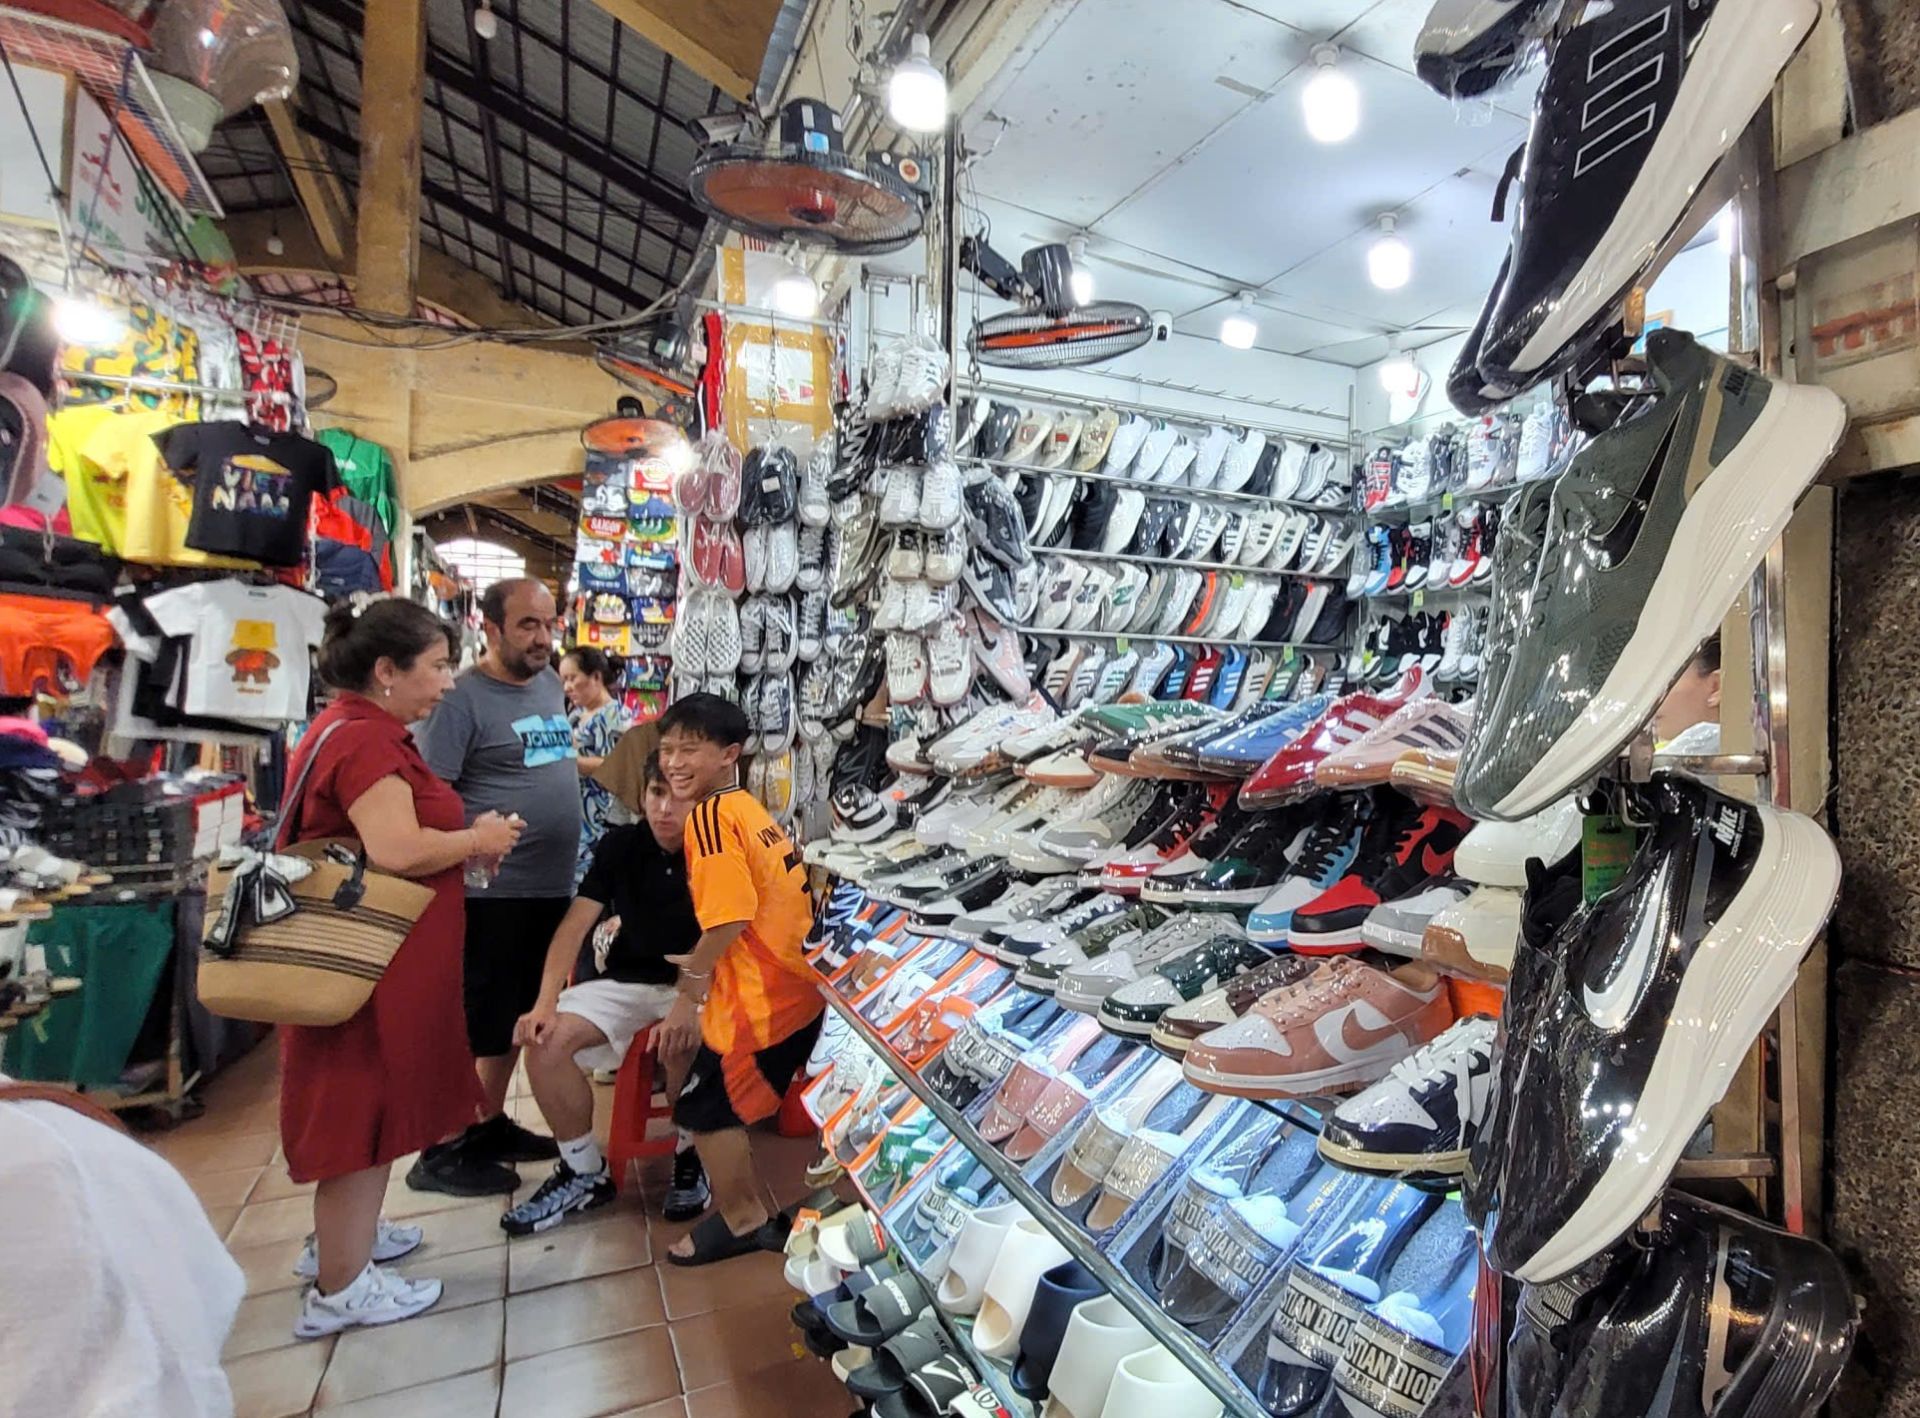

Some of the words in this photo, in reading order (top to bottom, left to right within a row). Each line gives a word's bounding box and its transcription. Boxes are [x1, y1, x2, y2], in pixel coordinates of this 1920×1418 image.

[222, 464, 292, 494] VIET
[211, 485, 290, 515] NAM
[590, 517, 622, 533] SAIGON
[1715, 804, 1739, 847] NIKE
[1345, 1366, 1374, 1390] PARIS
